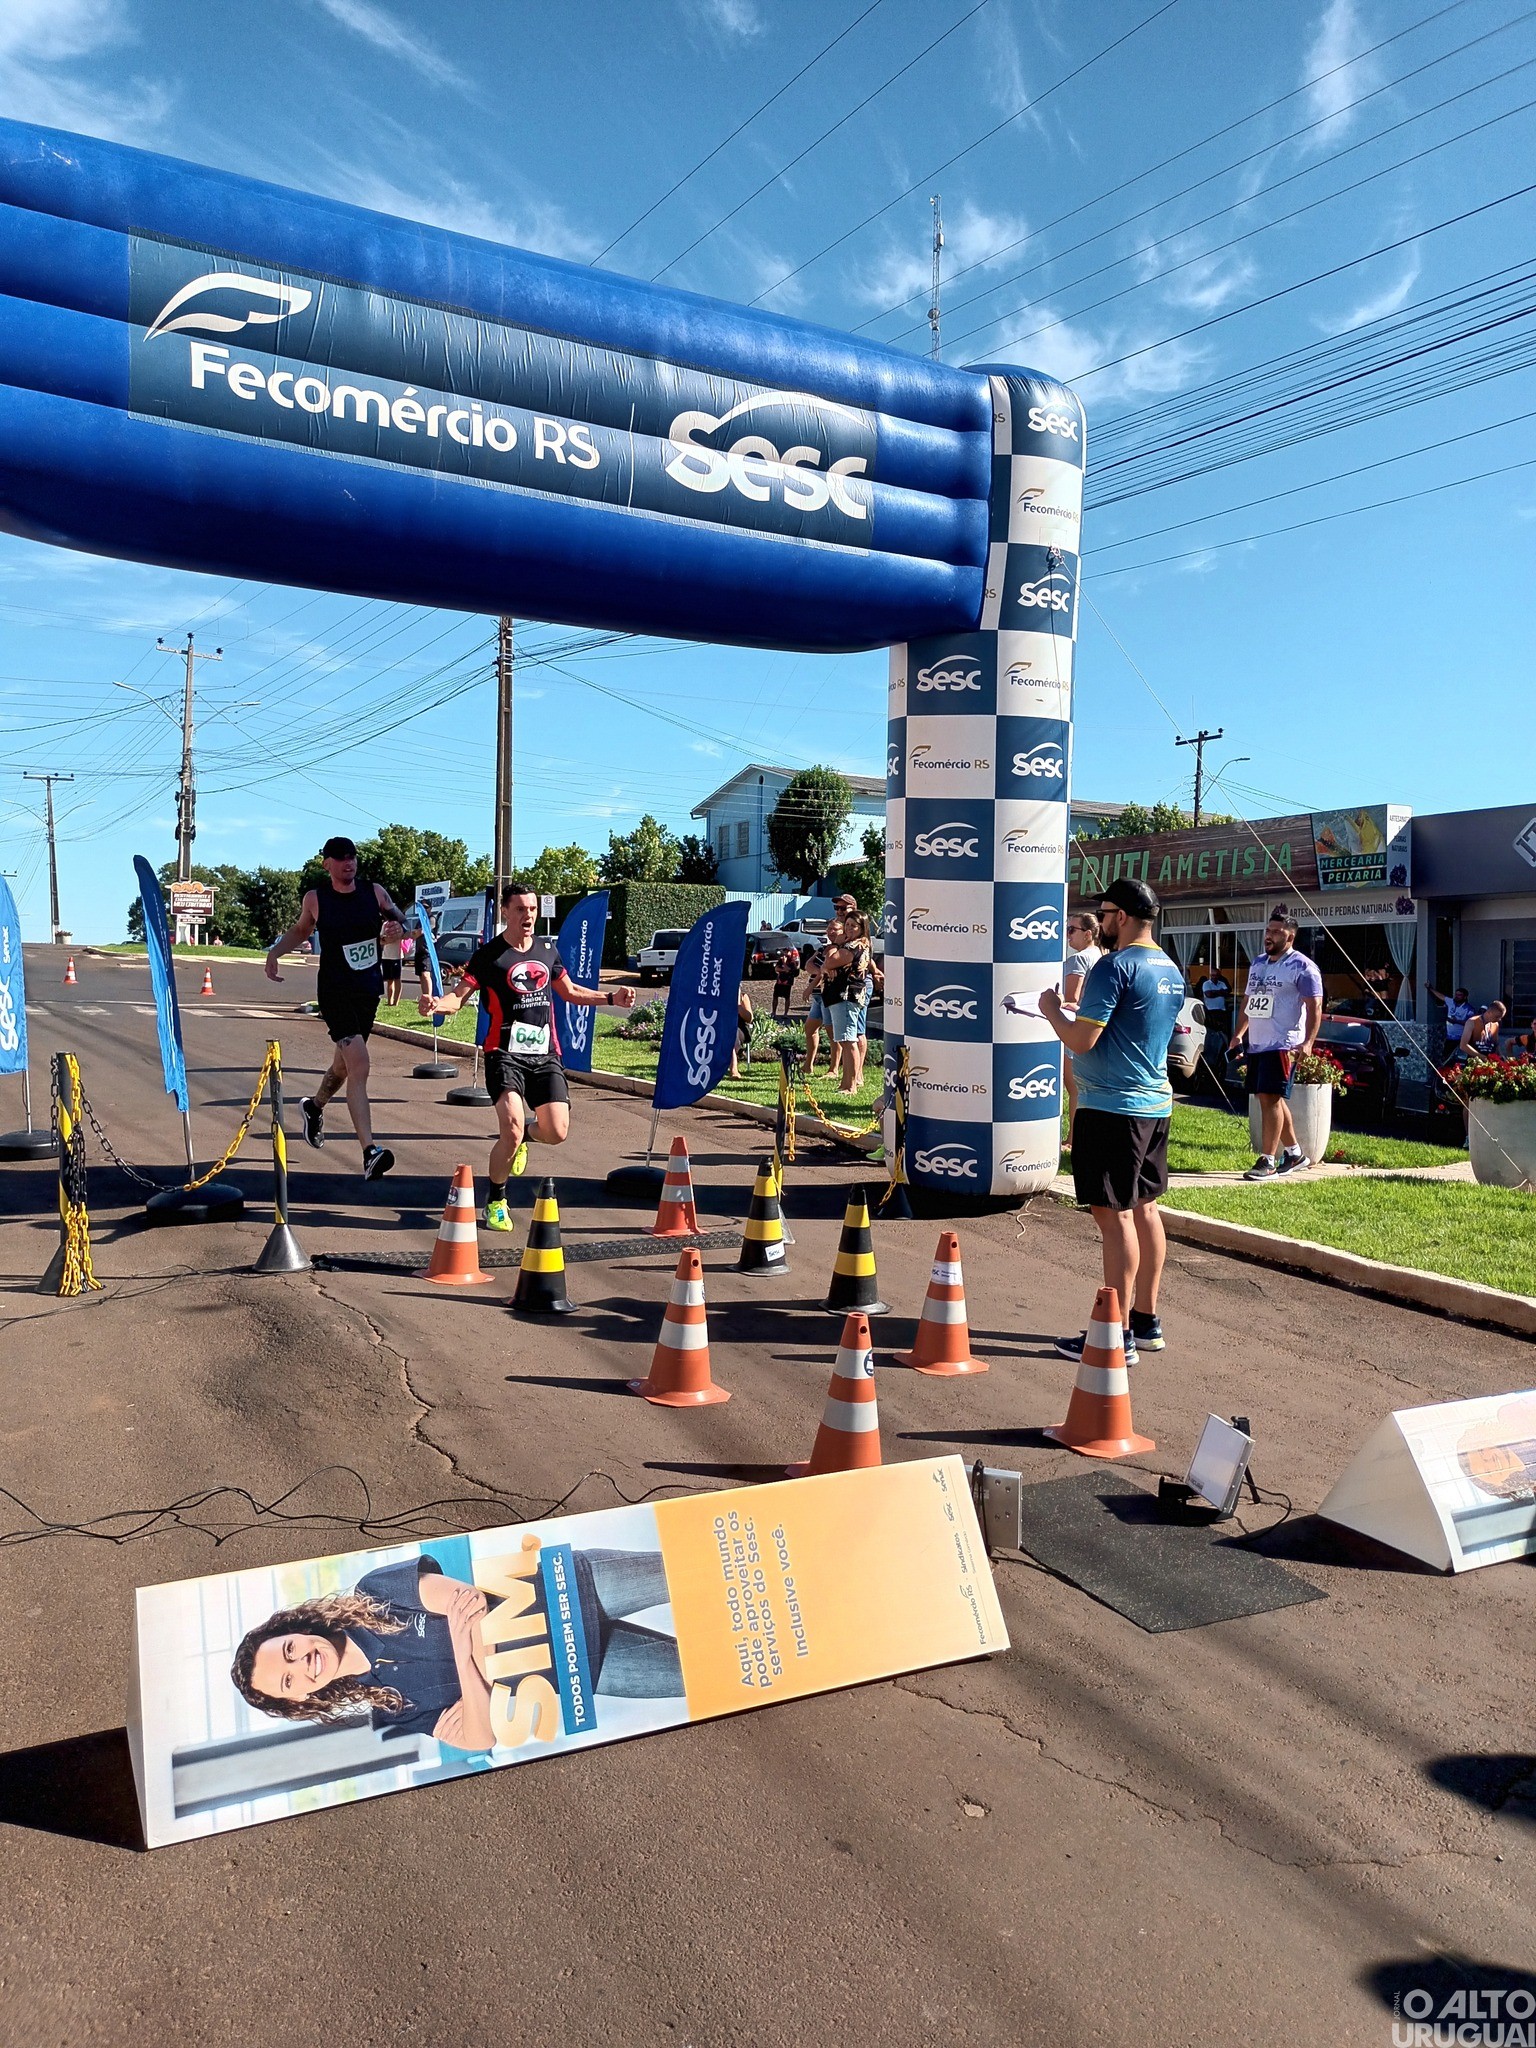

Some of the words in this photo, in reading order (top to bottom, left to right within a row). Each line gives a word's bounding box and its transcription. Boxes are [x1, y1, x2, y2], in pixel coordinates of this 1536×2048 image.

[189, 341, 518, 453] Fecomércio
[533, 416, 602, 470] RS
[1027, 405, 1079, 443] Sesc
[663, 404, 869, 521] Sesc
[1023, 502, 1073, 521] Fecomércio
[1017, 580, 1071, 613] Sesc
[916, 664, 982, 691] Sesc
[1010, 675, 1061, 690] Fecomércio
[913, 757, 971, 769] Fecomércio
[974, 759, 990, 770] RS
[1010, 749, 1064, 779] Sesc
[913, 829, 979, 858] Sesc
[1007, 841, 1057, 854] Fecomércio
[1069, 850, 1149, 896] FRUTI
[1158, 842, 1292, 882] AMETISTA
[1321, 854, 1385, 869] MERCEARIA
[1327, 869, 1382, 883] PEIXARIA
[1289, 907, 1328, 918] ARTESANATO
[1329, 906, 1334, 916] E
[1335, 904, 1360, 916] PEDRAS
[1361, 902, 1394, 915] NATURAIS
[911, 920, 969, 933] Fecomércio
[972, 924, 988, 934] RS
[1008, 913, 1060, 941] Sesc
[349, 942, 375, 963] 526
[577, 919, 588, 979] Fecomércio
[698, 921, 714, 995] Fecomércio
[711, 957, 723, 997] Senac
[912, 990, 978, 1020] Sesc
[1248, 997, 1270, 1011] 842
[685, 1007, 718, 1090] Sesc
[911, 1078, 969, 1093] Fecomércio
[971, 1084, 988, 1094] RS
[1007, 1072, 1057, 1100] Sesc
[913, 1147, 978, 1178] Sesc
[1005, 1159, 1051, 1173] Fecomércio
[728, 1511, 740, 1532] os
[714, 1516, 735, 1581] mundo
[745, 1516, 760, 1564] Sesc.
[771, 1523, 791, 1572] você.
[954, 1532, 968, 1574] Sindicatos
[553, 1551, 568, 1591] SESC.
[733, 1537, 760, 1632] aproveitar
[753, 1569, 766, 1593] do
[558, 1592, 572, 1620] SER
[965, 1584, 974, 1597] RS
[727, 1586, 744, 1632] todo
[784, 1576, 809, 1657] Inclusive
[969, 1598, 986, 1645] Fecomércio
[417, 1612, 427, 1639] Sesc
[760, 1599, 783, 1676] serviços
[563, 1622, 580, 1673] PODEM
[735, 1636, 755, 1687] Aqui,
[752, 1638, 773, 1688] pode
[569, 1677, 586, 1726] TODOS
